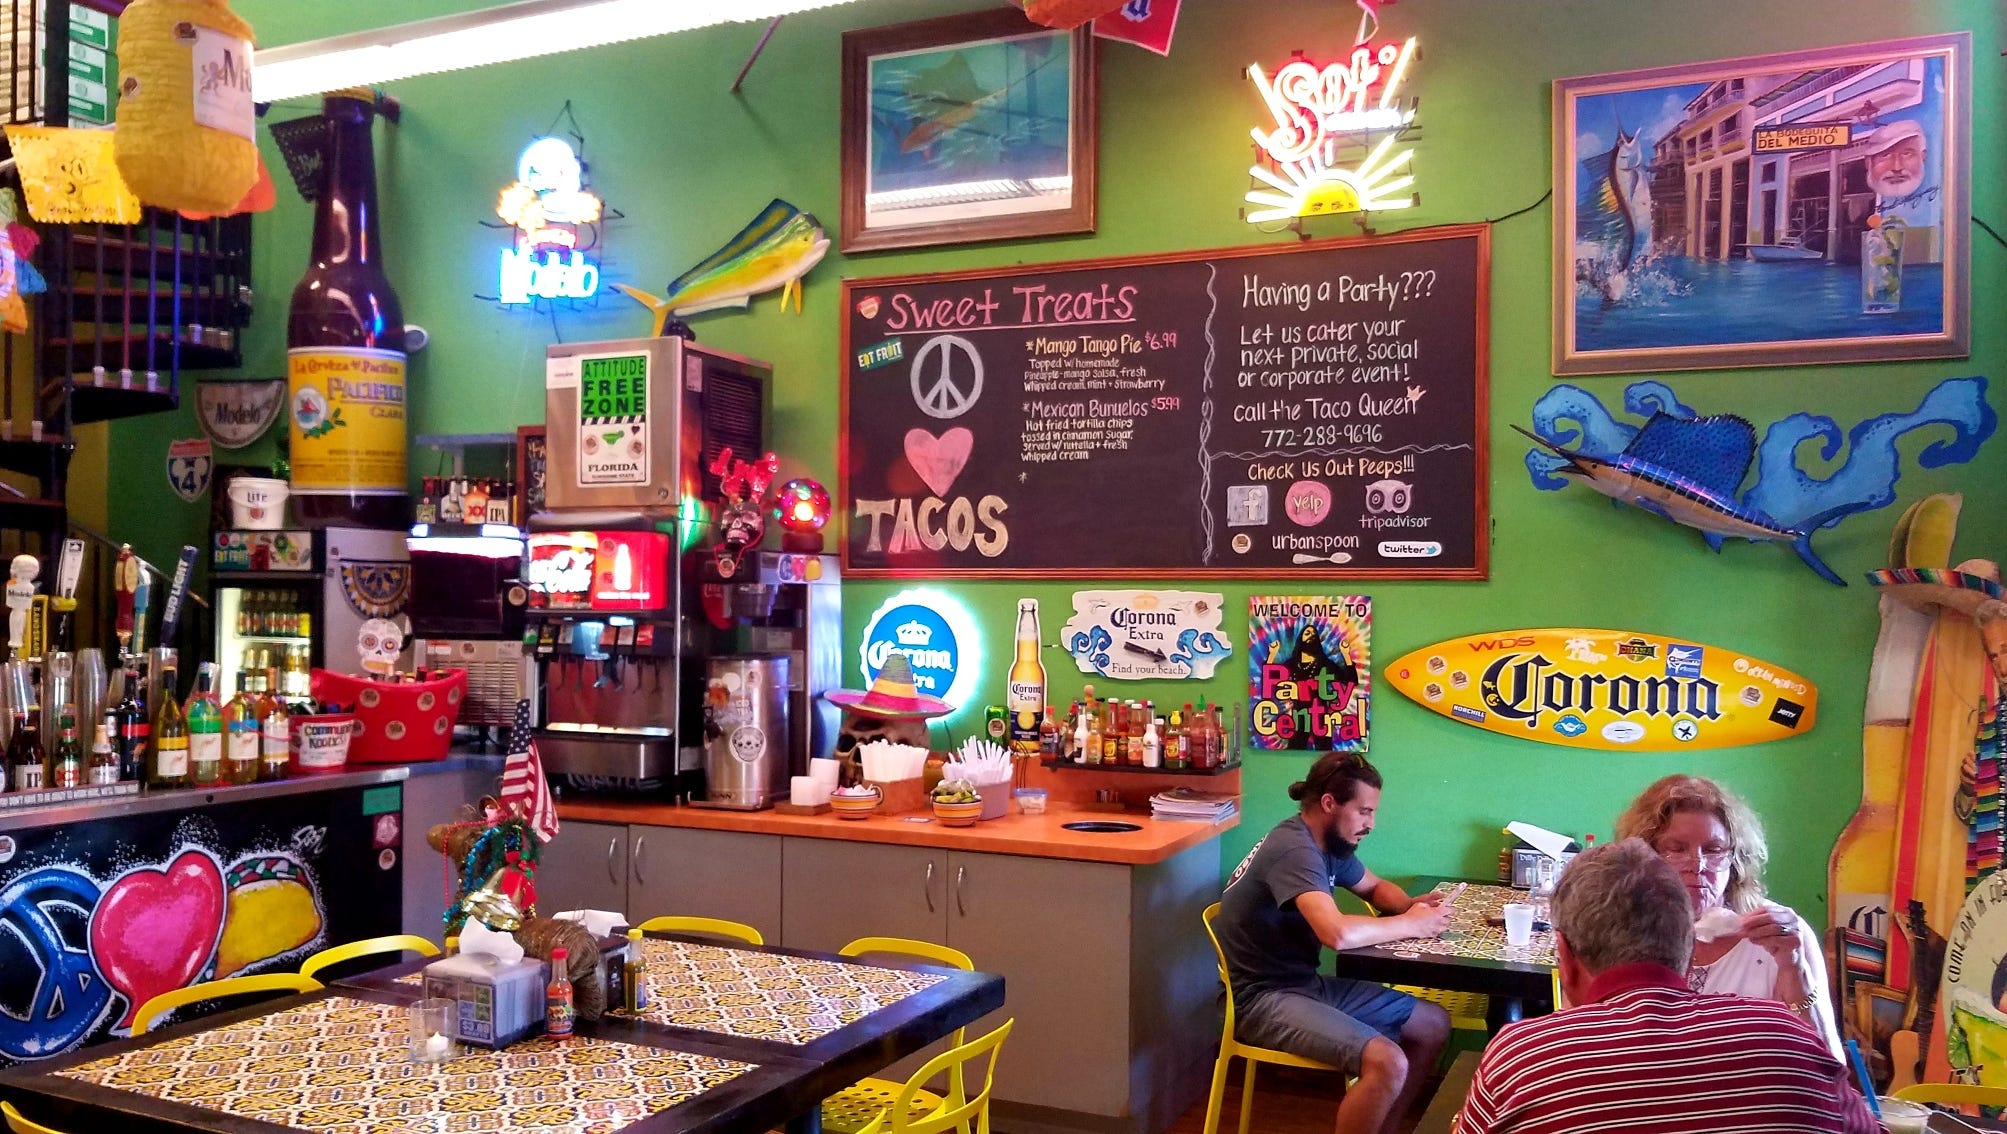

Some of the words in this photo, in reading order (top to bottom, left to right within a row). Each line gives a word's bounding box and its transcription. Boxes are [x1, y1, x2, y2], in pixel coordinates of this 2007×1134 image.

[1758, 139, 1782, 149] DEL
[1788, 134, 1835, 146] MEDIO
[1243, 274, 1312, 311] Having
[1317, 282, 1330, 301] a
[1338, 270, 1436, 311] Party???
[887, 288, 1000, 330] Sweet
[1012, 283, 1138, 323] Treats
[1240, 323, 1274, 345] Let
[1282, 326, 1301, 344] us
[1307, 320, 1358, 343] cater
[1362, 319, 1406, 344] your
[1078, 335, 1116, 357] Tango
[1121, 334, 1142, 354] Pie
[1144, 330, 1178, 350] $6.99
[1240, 347, 1285, 367] next
[1291, 343, 1362, 369] private,
[1367, 339, 1418, 360] social
[583, 358, 645, 378] ATTITUDE
[1028, 358, 1062, 371] Topped
[1119, 366, 1146, 378] fresh
[1087, 379, 1106, 391] mint
[1237, 370, 1256, 388] or
[1260, 364, 1345, 391] corporate
[1351, 362, 1410, 384] event!
[583, 378, 645, 397] FREE
[215, 402, 261, 425] Modelo
[582, 397, 645, 415] ZONE
[1031, 400, 1085, 419] Mexican
[1269, 399, 1301, 421] the
[1305, 397, 1351, 420] Taco
[1358, 392, 1417, 417] Queen
[1025, 419, 1043, 432] Hot
[1046, 418, 1068, 430] fried
[1070, 418, 1105, 430] tortilla
[1107, 418, 1133, 430] chips
[1021, 431, 1050, 443] tossed
[1052, 431, 1061, 441] in
[1261, 424, 1382, 448] 772-288-9696
[1022, 440, 1050, 453] served
[1102, 439, 1128, 450] fresh
[1059, 450, 1089, 460] cream
[588, 462, 638, 473] FLORIDA
[1247, 461, 1294, 481] Check
[1301, 459, 1320, 479] Us
[1325, 457, 1355, 477] Out
[1358, 454, 1415, 479] Peeps!!!
[181, 470, 197, 494] 4
[468, 506, 485, 517] XX
[489, 508, 506, 522] IPA
[855, 495, 1009, 558] TACOS
[1358, 514, 1432, 532] tripadvisor
[1271, 533, 1360, 552] urbanspoon
[1383, 544, 1426, 555] twitter
[1110, 607, 1177, 628] Corona
[1254, 603, 1339, 618] WELCOME
[1345, 603, 1367, 618] TO
[1129, 627, 1164, 641] Extra
[1468, 636, 1536, 652] WDS
[867, 639, 954, 673] Crona
[1112, 662, 1133, 675] Find
[1135, 665, 1157, 677] your
[1158, 662, 1188, 676] beach.
[1261, 663, 1355, 711] Party
[1480, 652, 1723, 729] Corona
[1019, 694, 1037, 702] Extra
[1253, 697, 1367, 741] Central
